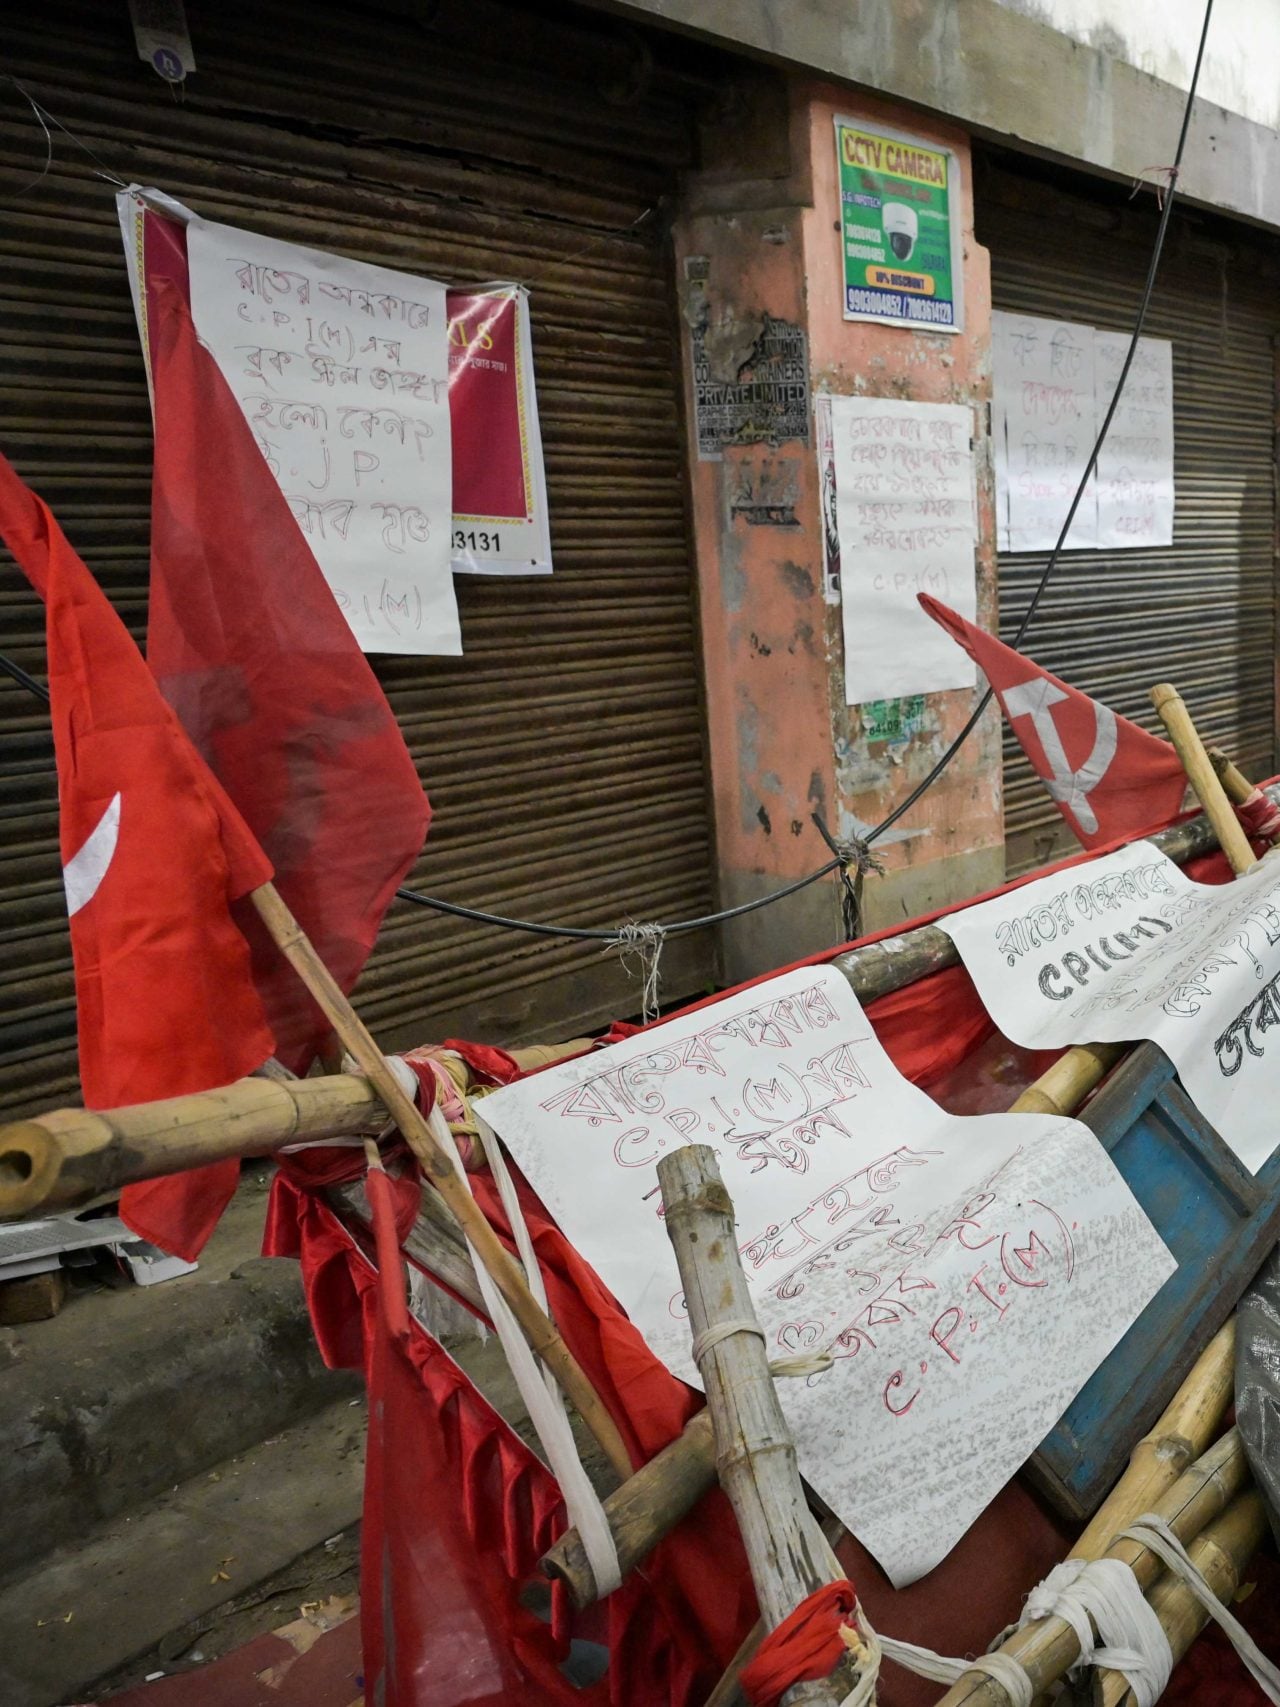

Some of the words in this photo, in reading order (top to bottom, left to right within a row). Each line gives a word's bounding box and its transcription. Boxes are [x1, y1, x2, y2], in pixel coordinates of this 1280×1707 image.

[845, 134, 881, 168] CCTV
[886, 144, 943, 184] CAMERA
[697, 386, 750, 406] PRIVATE
[753, 383, 807, 404] LIMITED
